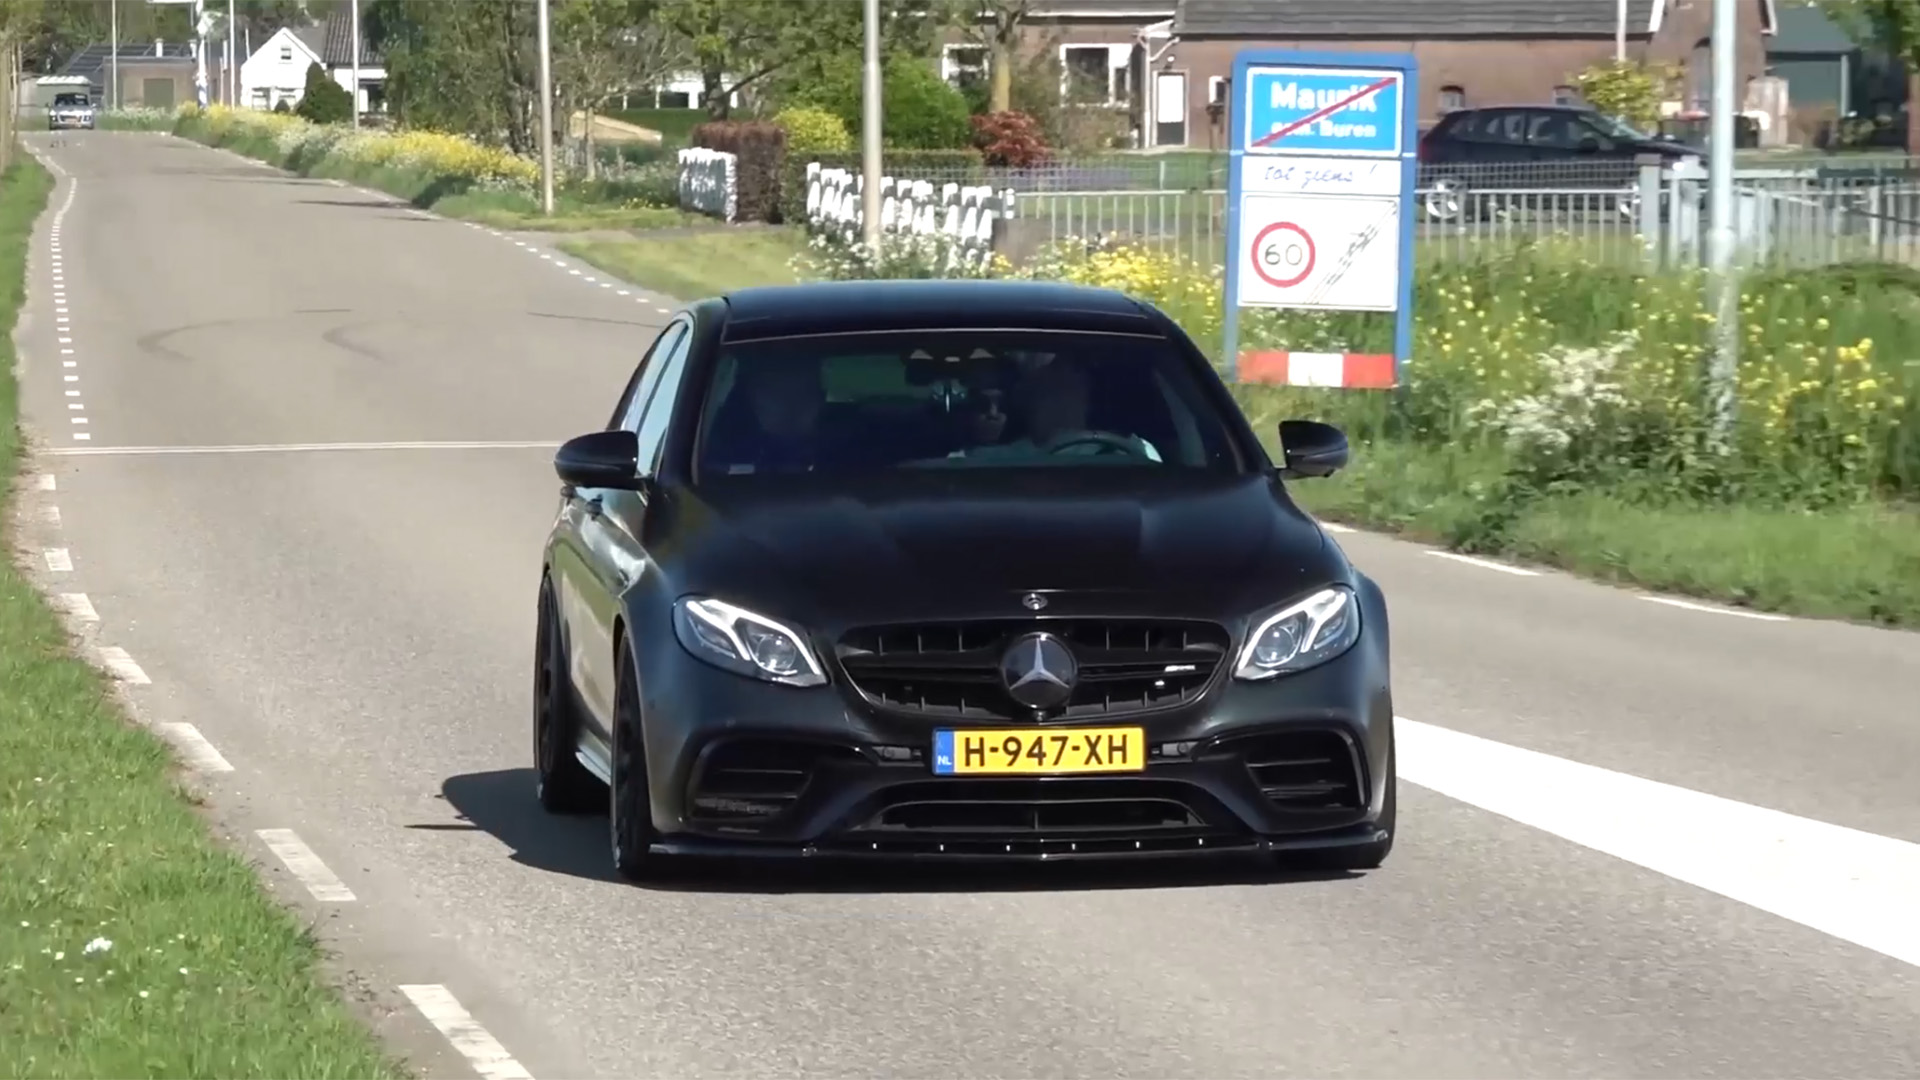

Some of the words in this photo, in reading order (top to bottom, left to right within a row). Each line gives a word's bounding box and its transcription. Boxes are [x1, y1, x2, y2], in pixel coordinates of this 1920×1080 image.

[1270, 81, 1377, 112] Maurik
[1319, 120, 1377, 137] Buren
[1264, 244, 1303, 265] 60
[937, 756, 952, 765] NL
[964, 734, 1128, 767] H-947-XH
